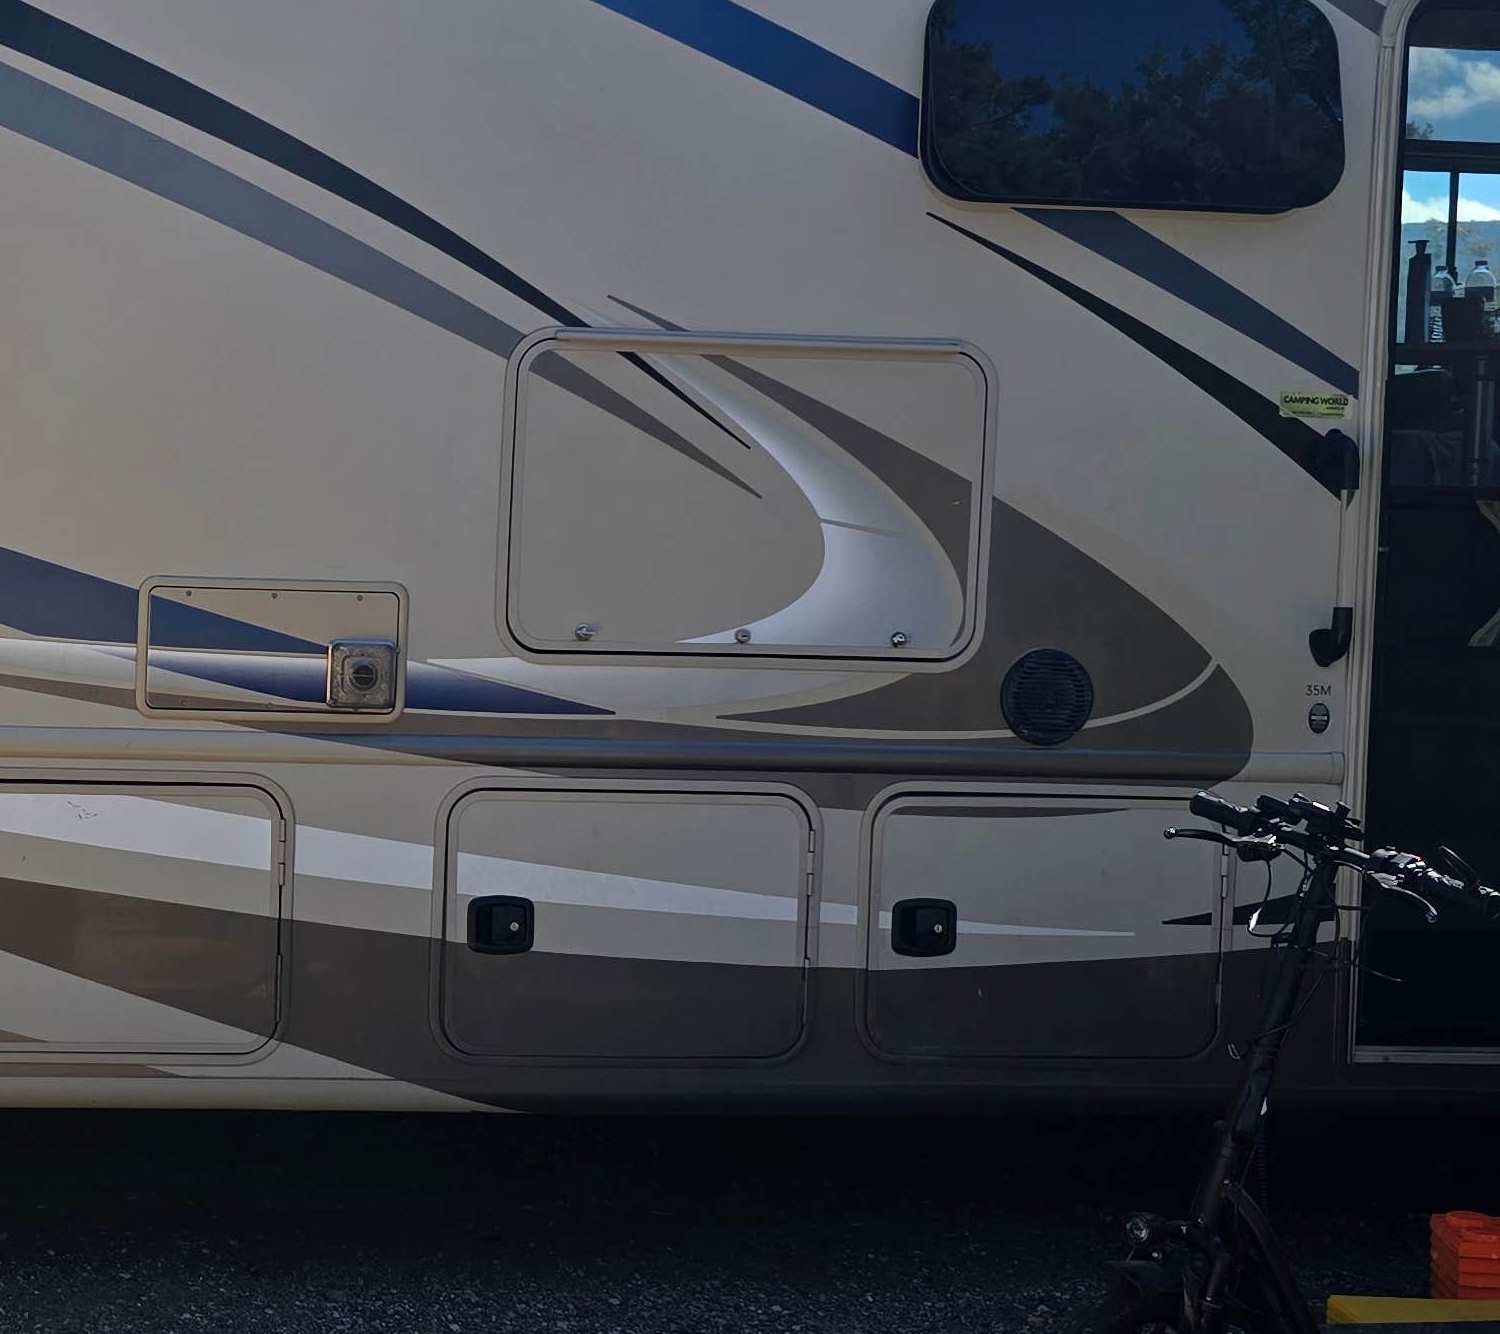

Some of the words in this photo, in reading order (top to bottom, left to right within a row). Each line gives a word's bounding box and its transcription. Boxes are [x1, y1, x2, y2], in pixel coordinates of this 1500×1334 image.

[1283, 395, 1319, 405] CAMPING
[1320, 396, 1349, 406] WORLD
[1305, 684, 1332, 696] 35M
